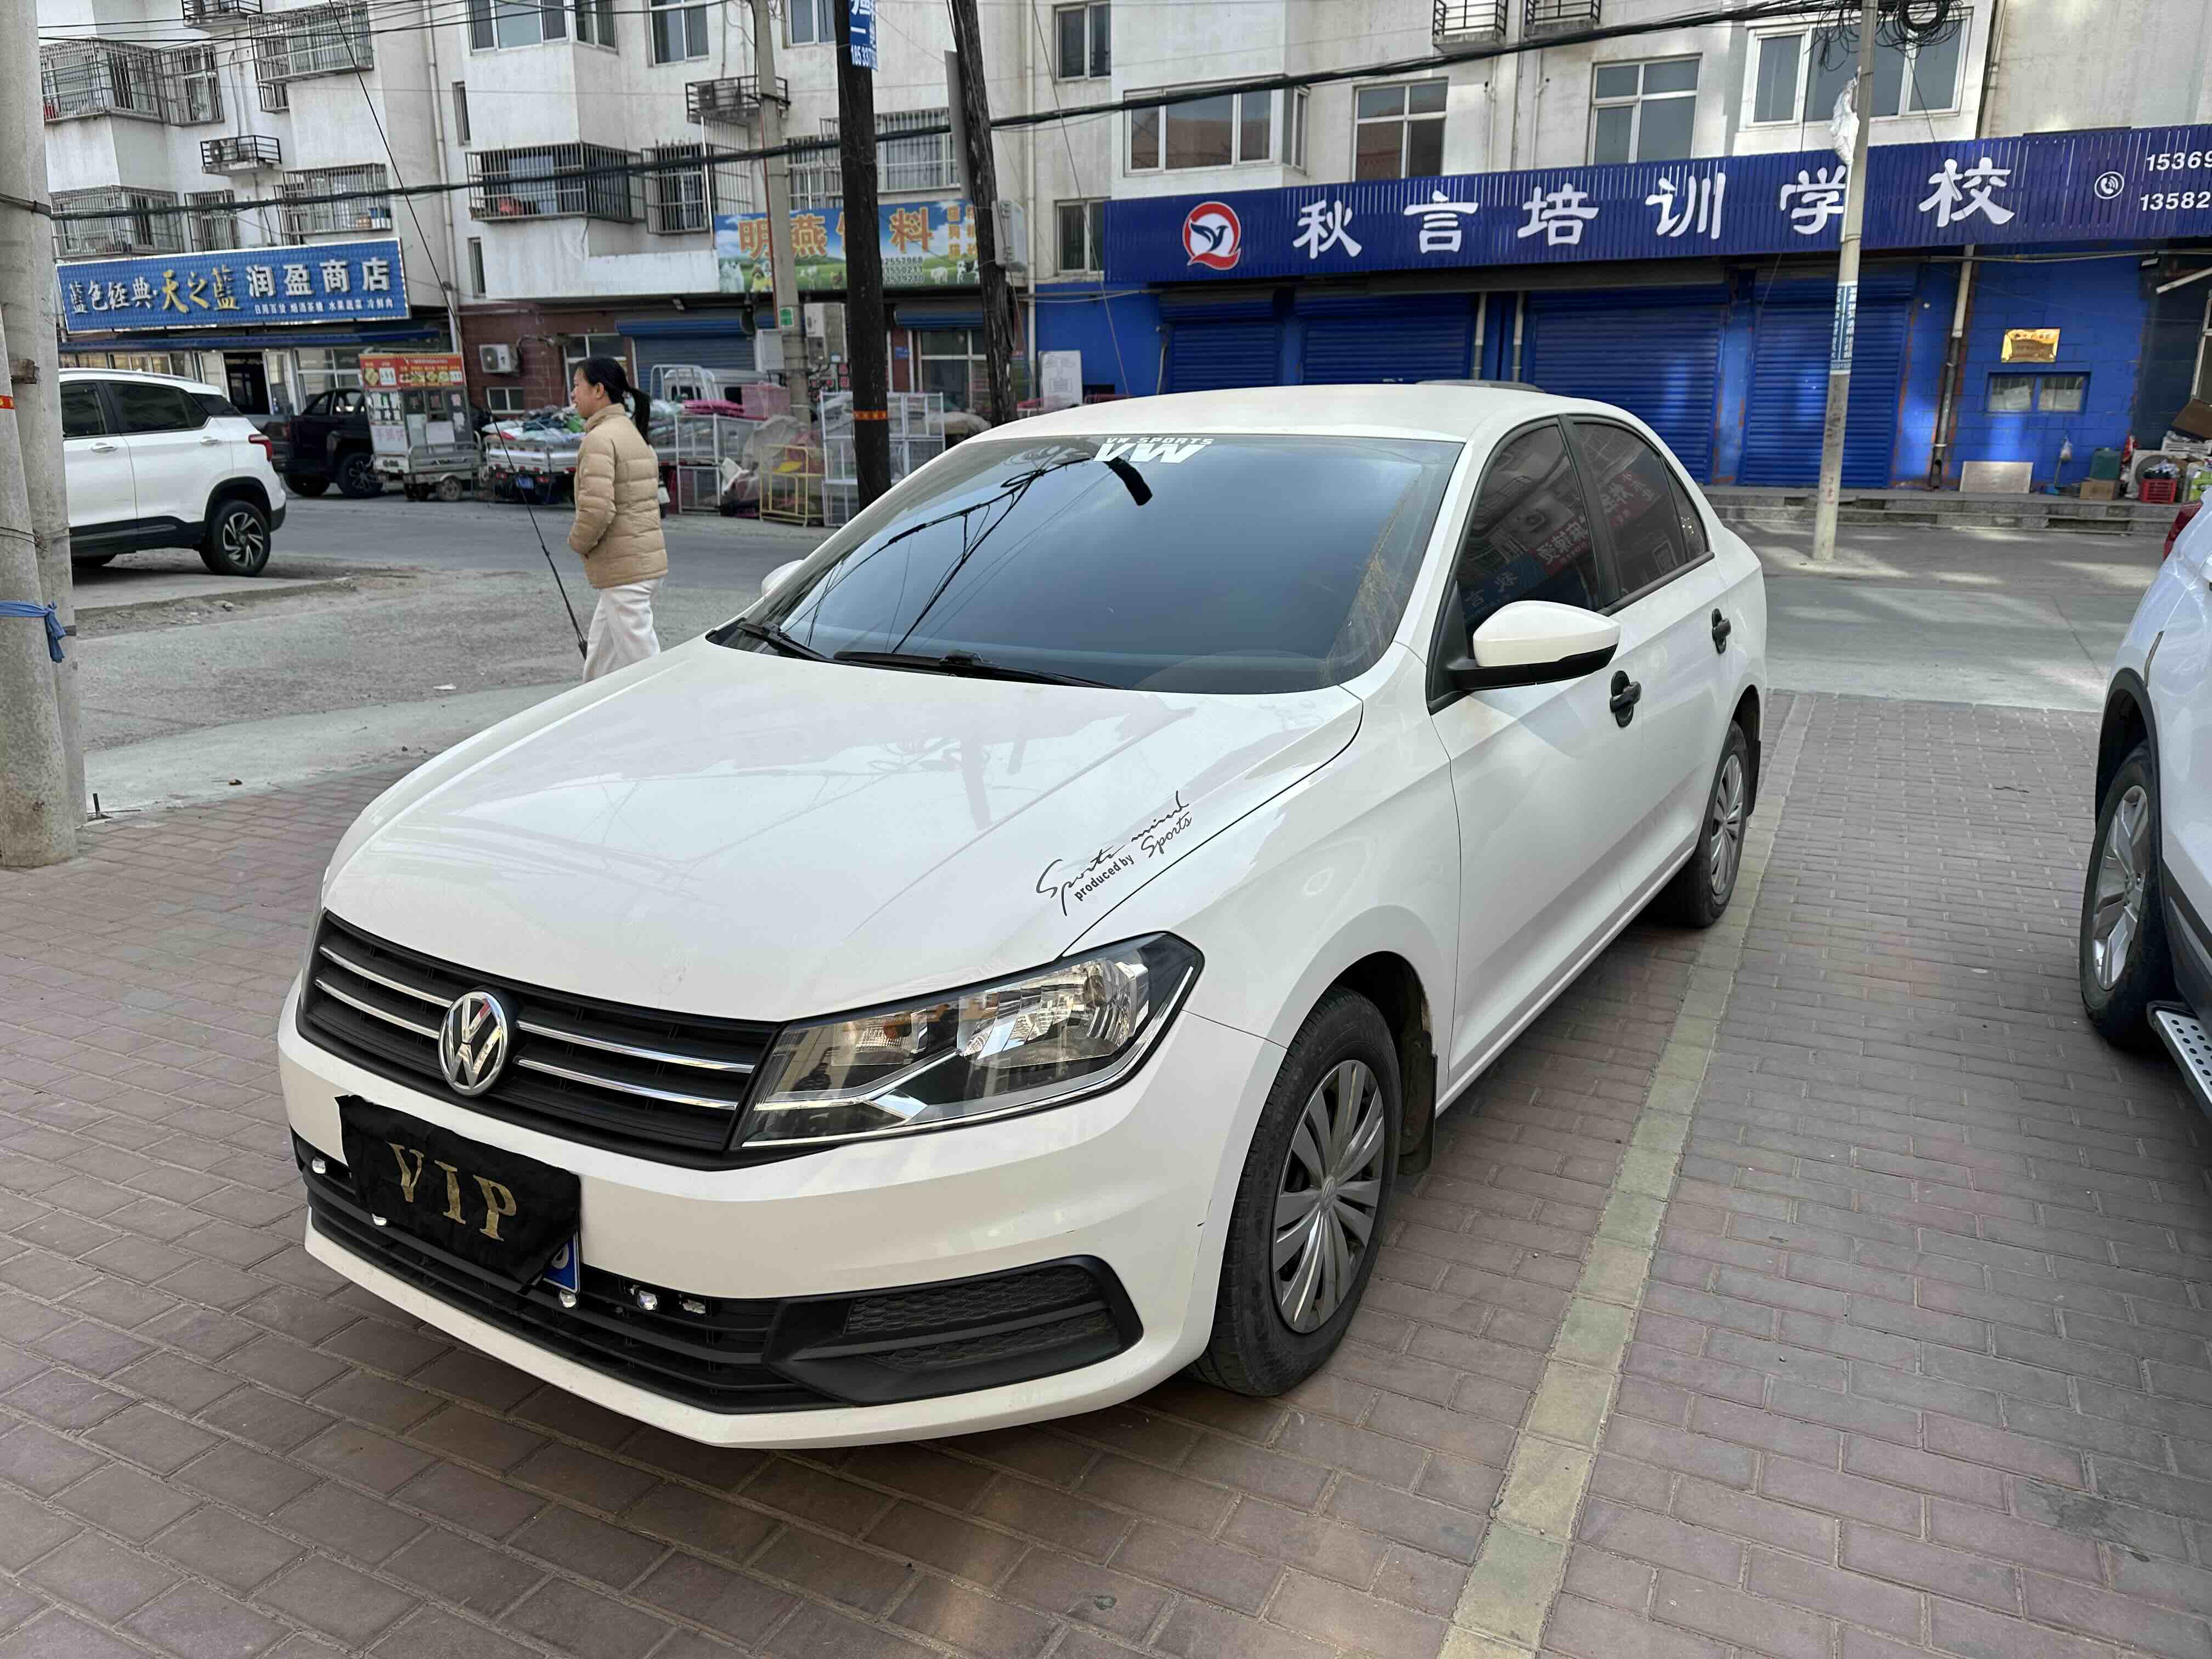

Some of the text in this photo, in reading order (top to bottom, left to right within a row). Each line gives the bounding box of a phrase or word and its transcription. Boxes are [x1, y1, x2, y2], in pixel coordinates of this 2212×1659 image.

[2146, 150, 2212, 172] 15369
[1293, 157, 2015, 259] 秋言培训学校
[2140, 190, 2211, 211] 13582
[738, 206, 934, 259] 明燕料
[246, 257, 390, 298] 润盈商店
[1093, 443, 1207, 463] VW
[1074, 811, 1193, 902] produced by Sports
[390, 1142, 517, 1242] VIP
